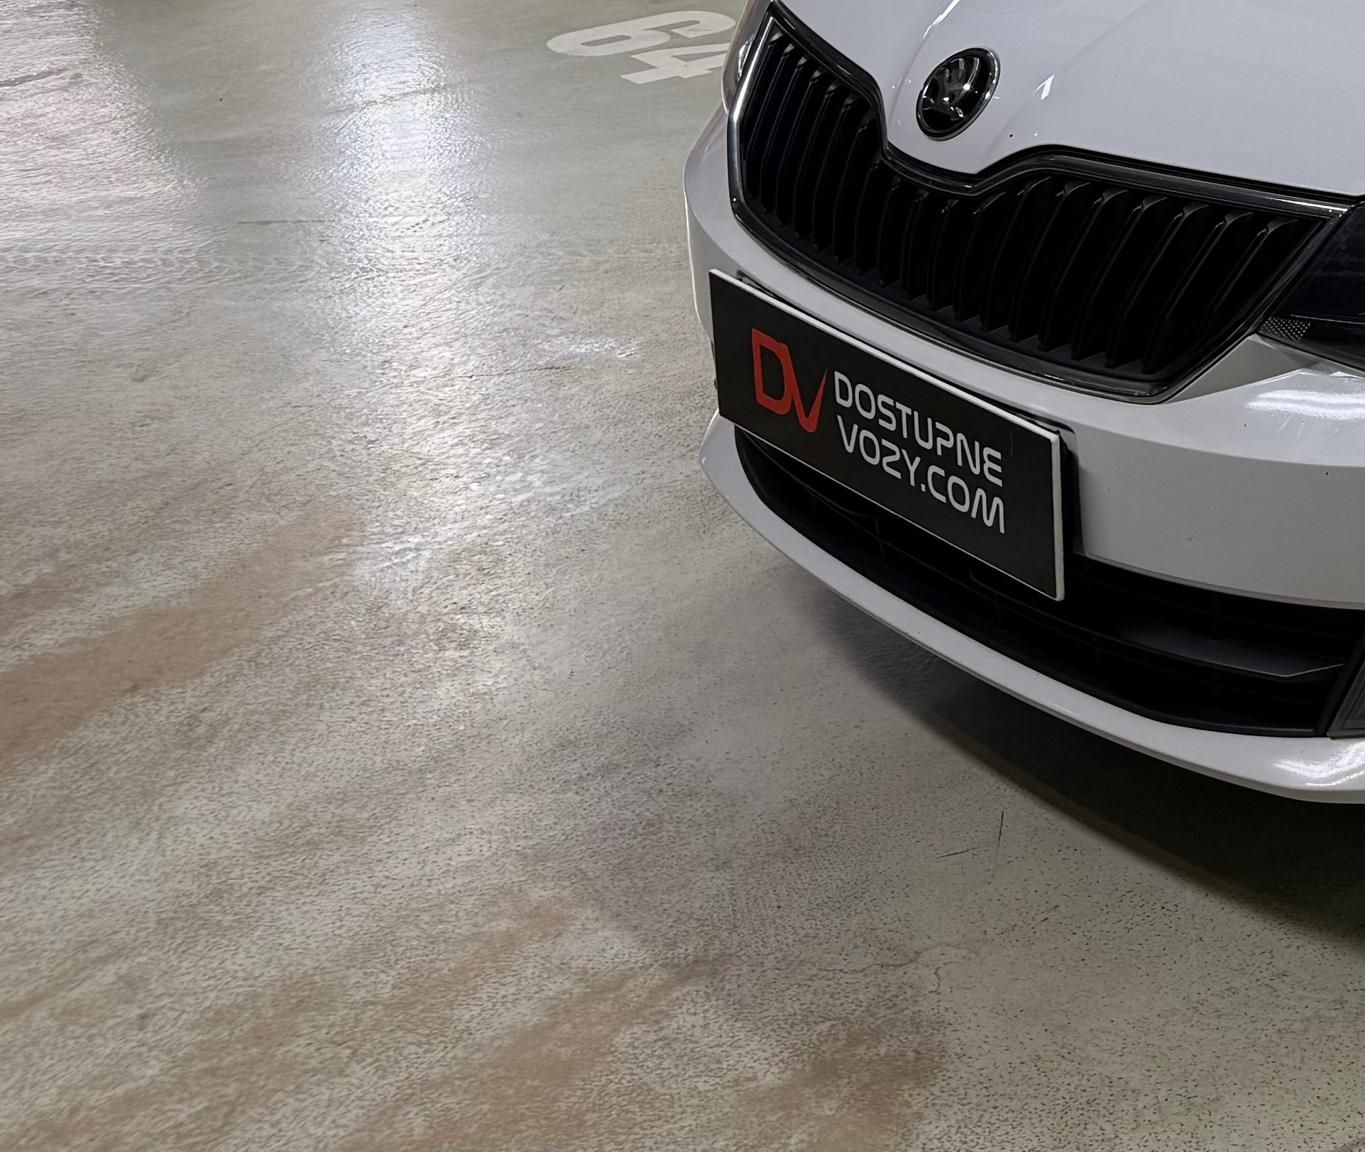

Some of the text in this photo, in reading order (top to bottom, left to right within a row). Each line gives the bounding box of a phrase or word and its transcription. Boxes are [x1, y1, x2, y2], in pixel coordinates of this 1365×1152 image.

[751, 327, 828, 433] DV
[834, 370, 1003, 487] DOSTUPNE
[836, 414, 1005, 534] VOZY.COM
